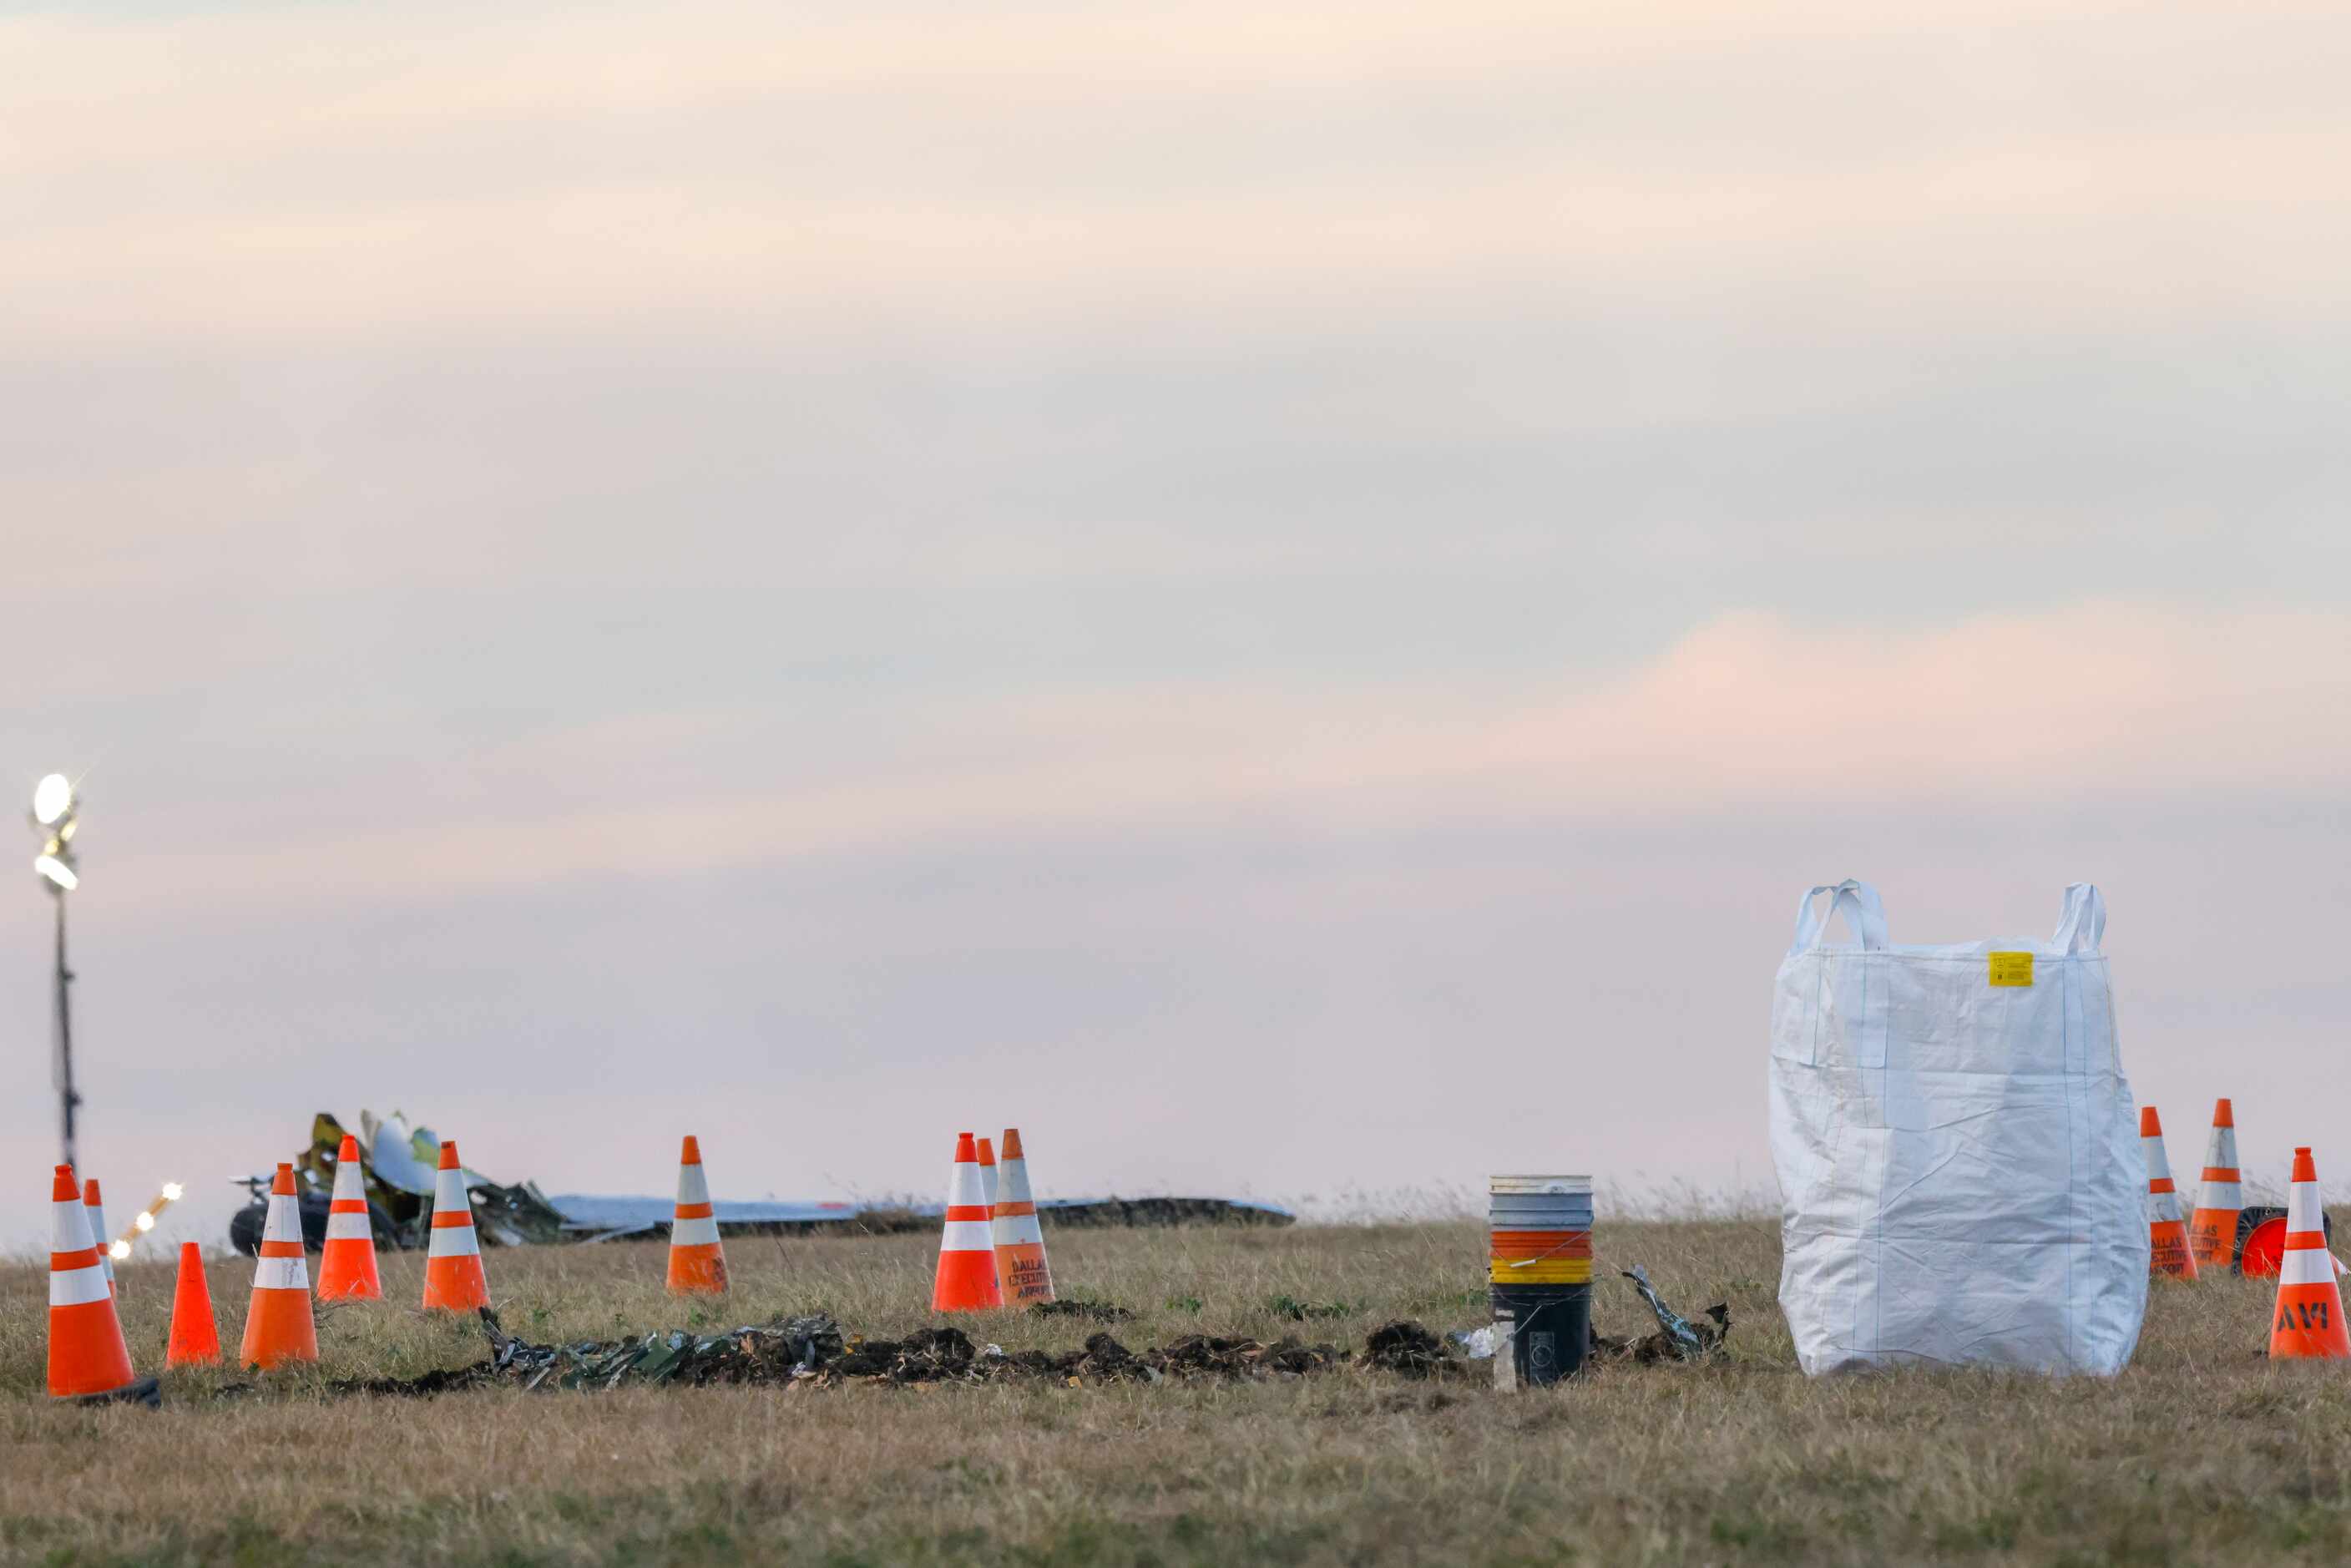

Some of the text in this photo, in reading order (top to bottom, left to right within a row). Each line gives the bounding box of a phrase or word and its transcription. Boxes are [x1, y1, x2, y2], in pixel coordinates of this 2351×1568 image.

[2151, 1236, 2182, 1250] ALLAS
[1012, 1259, 1045, 1272] DALLA
[2277, 1302, 2328, 1333] AVI
